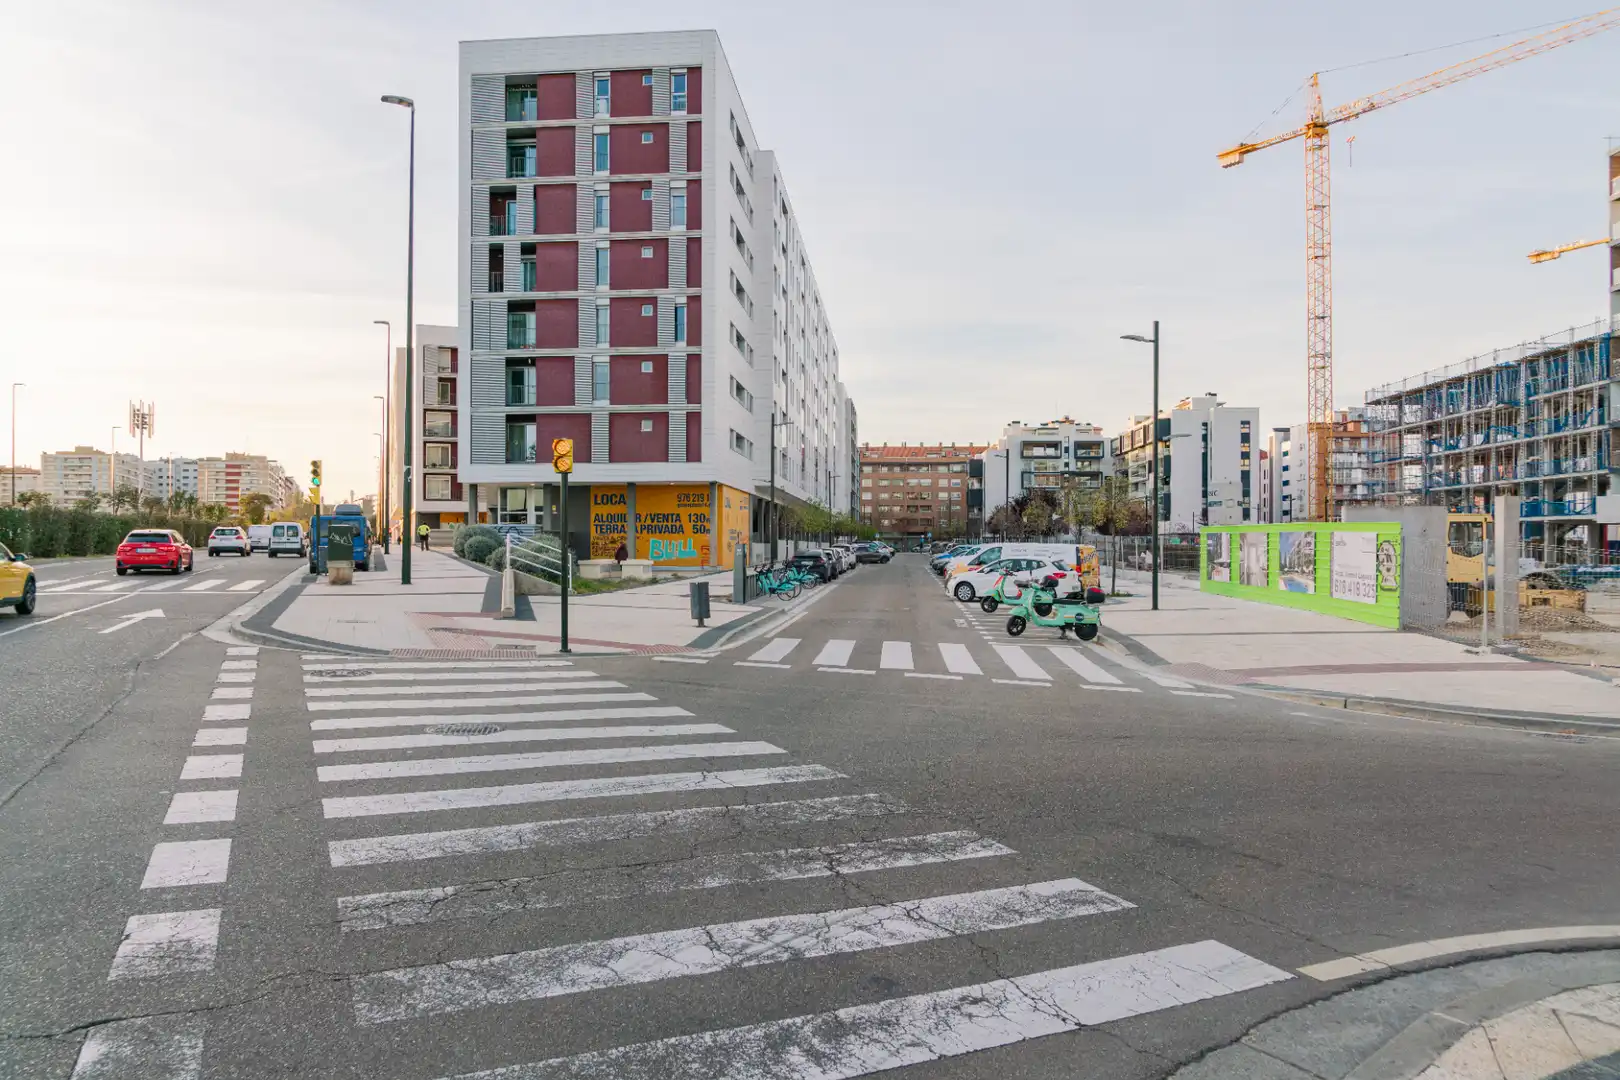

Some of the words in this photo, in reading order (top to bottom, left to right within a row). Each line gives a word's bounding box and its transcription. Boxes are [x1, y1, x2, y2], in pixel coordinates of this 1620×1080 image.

[594, 494, 627, 505] LOCA
[594, 513, 642, 523] ALQUILR
[640, 523, 685, 535] PRIVADA
